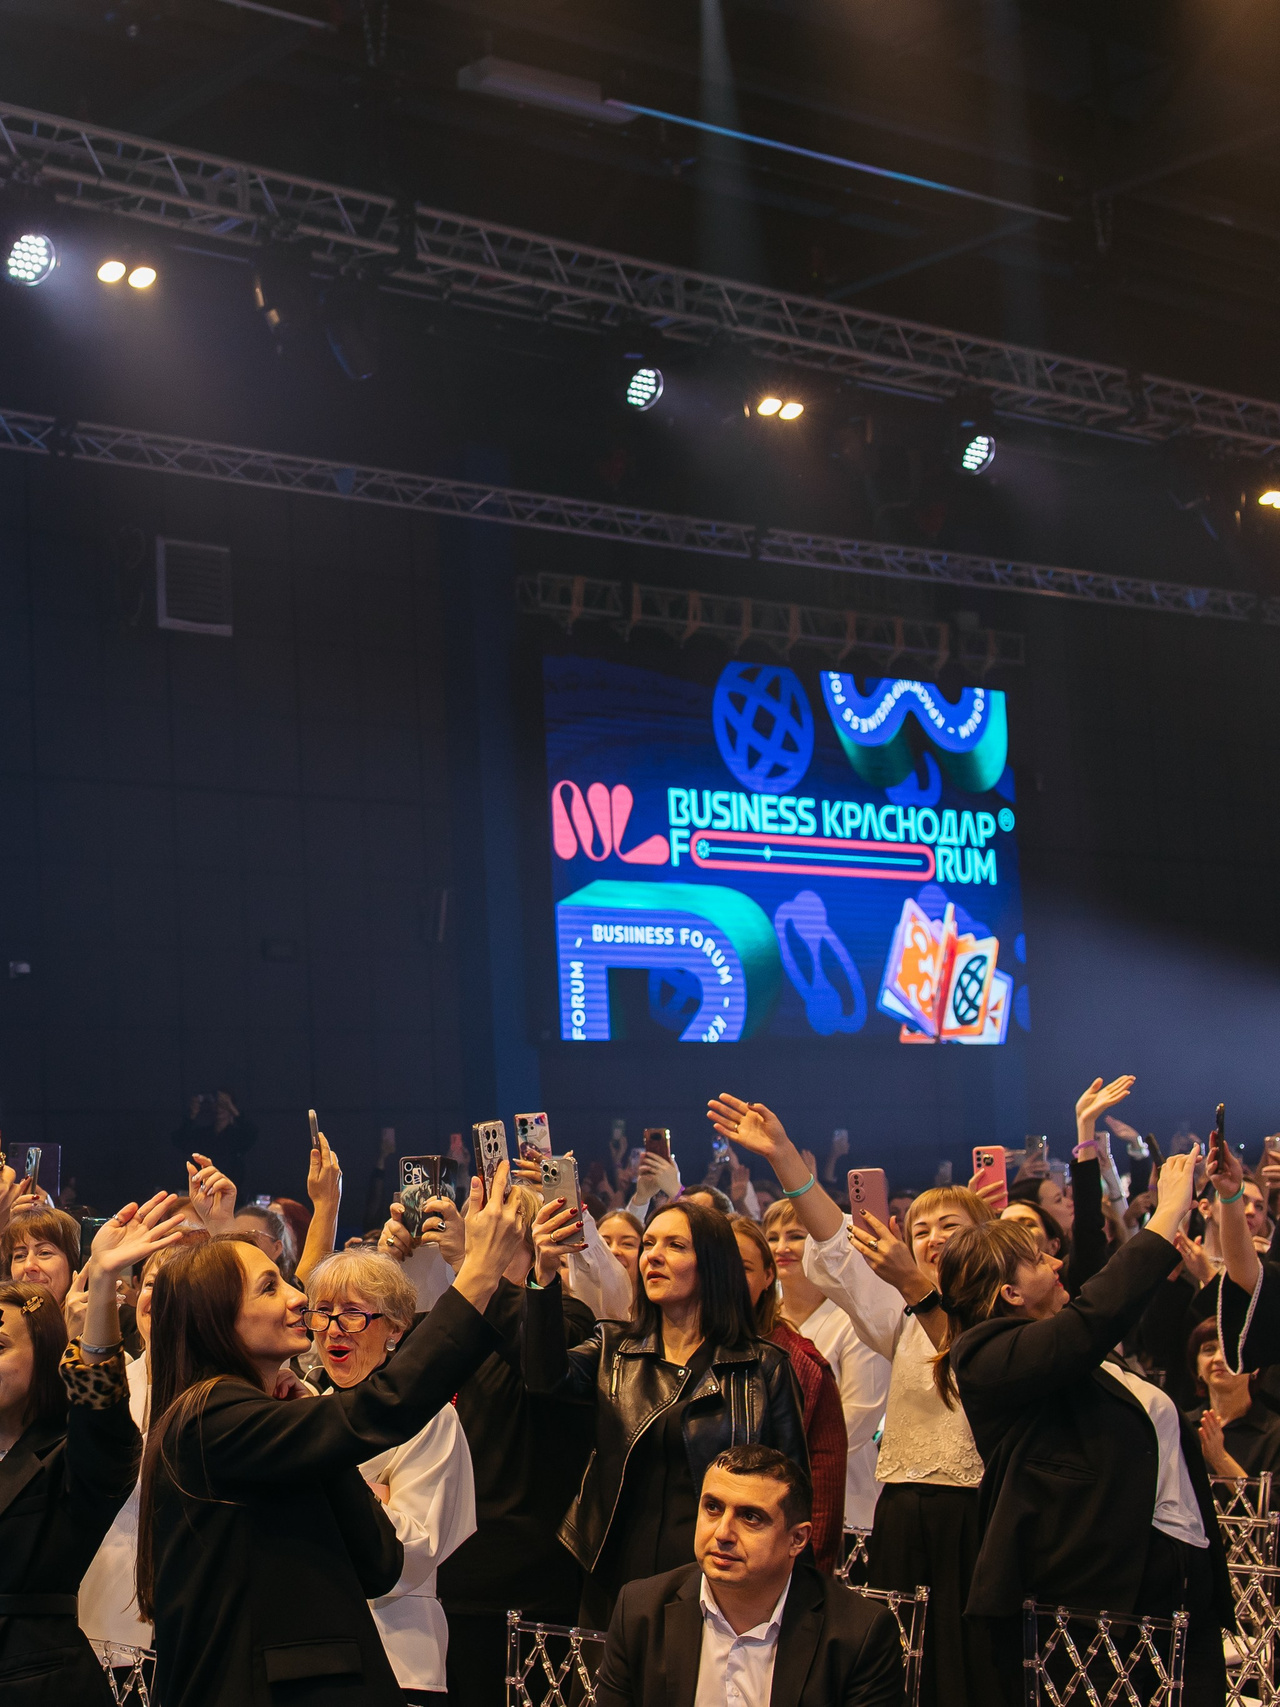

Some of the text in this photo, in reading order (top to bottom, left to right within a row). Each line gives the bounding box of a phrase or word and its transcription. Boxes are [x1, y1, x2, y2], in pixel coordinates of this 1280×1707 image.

[668, 787, 818, 836] BUSINESS
[821, 799, 997, 848] КРАСНОДАР
[591, 924, 675, 945] BUSIINESS
[679, 927, 733, 985] FORUM
[569, 961, 587, 1041] FORUM
[701, 1014, 727, 1042] КР
